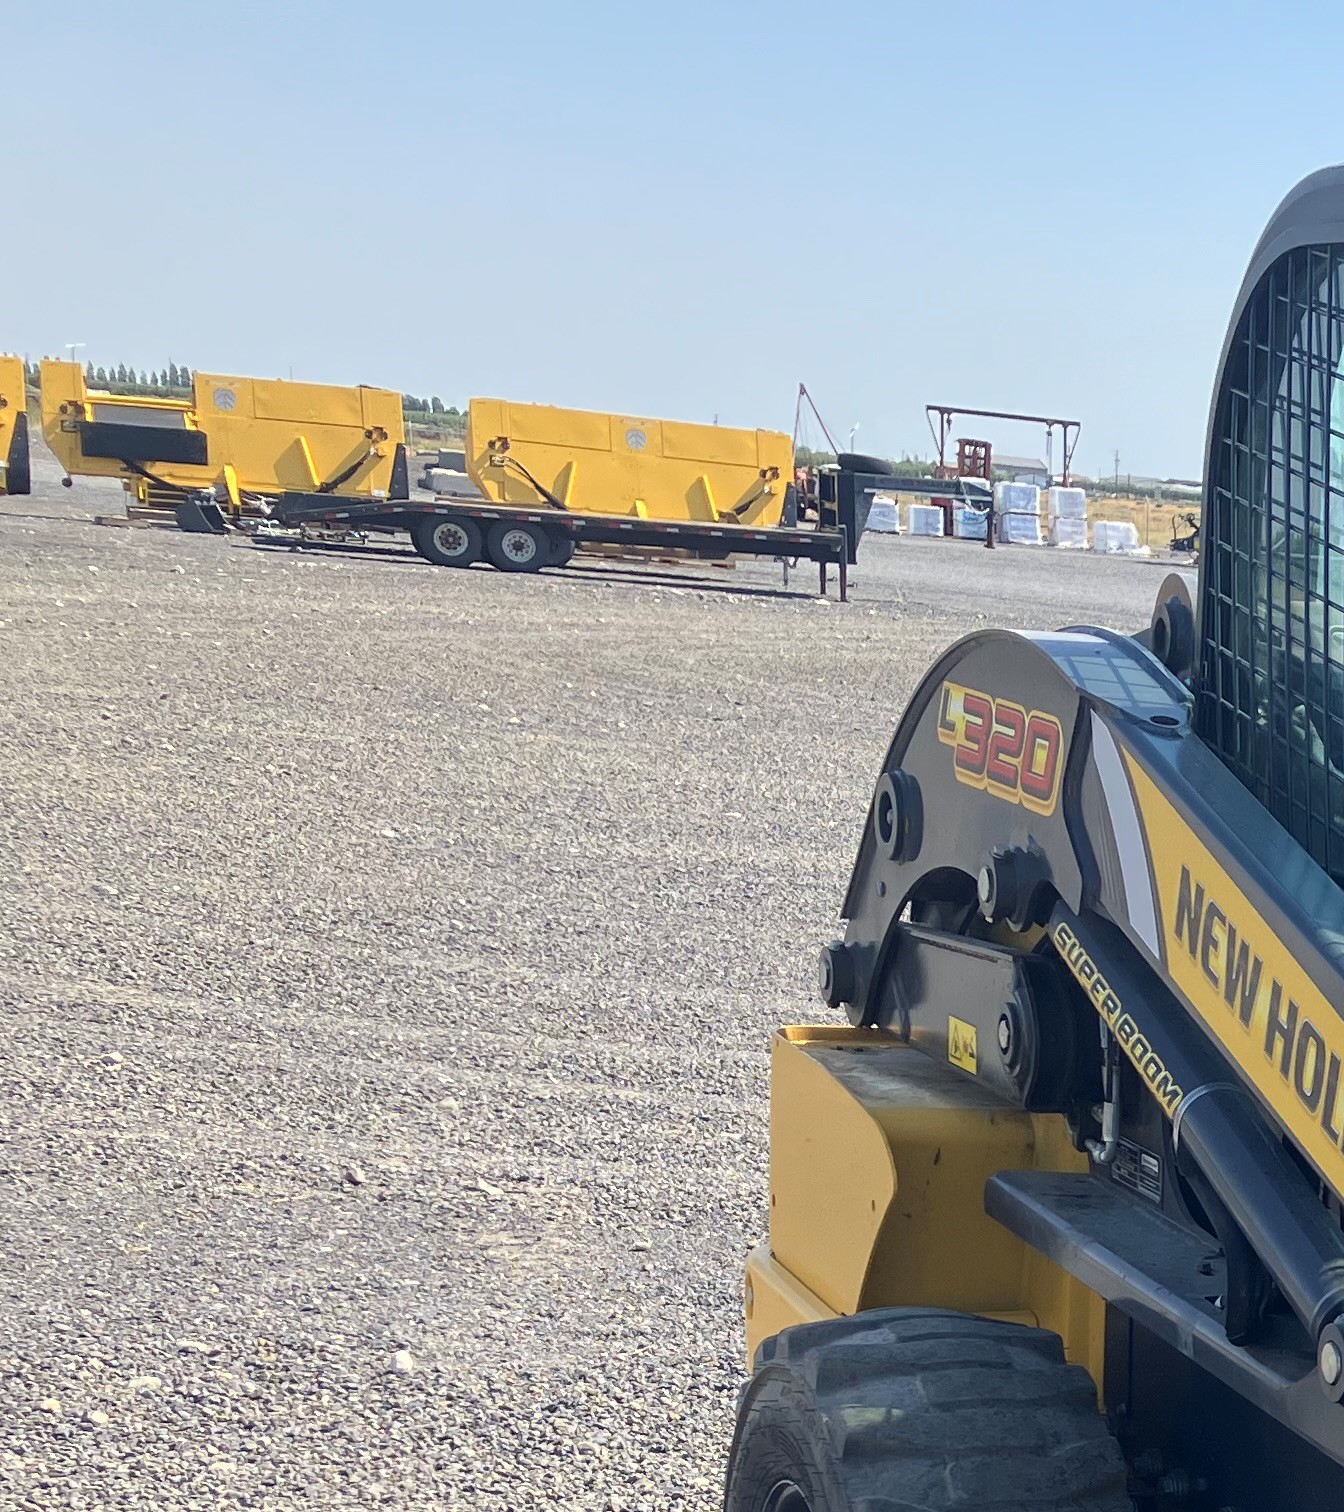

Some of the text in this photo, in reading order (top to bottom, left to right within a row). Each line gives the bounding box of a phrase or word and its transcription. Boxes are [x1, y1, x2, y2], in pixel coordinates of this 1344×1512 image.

[938, 681, 1064, 816] L320
[1053, 922, 1122, 1027] SUPER
[1114, 1013, 1184, 1119] BOOM
[1175, 863, 1264, 1029] NEW
